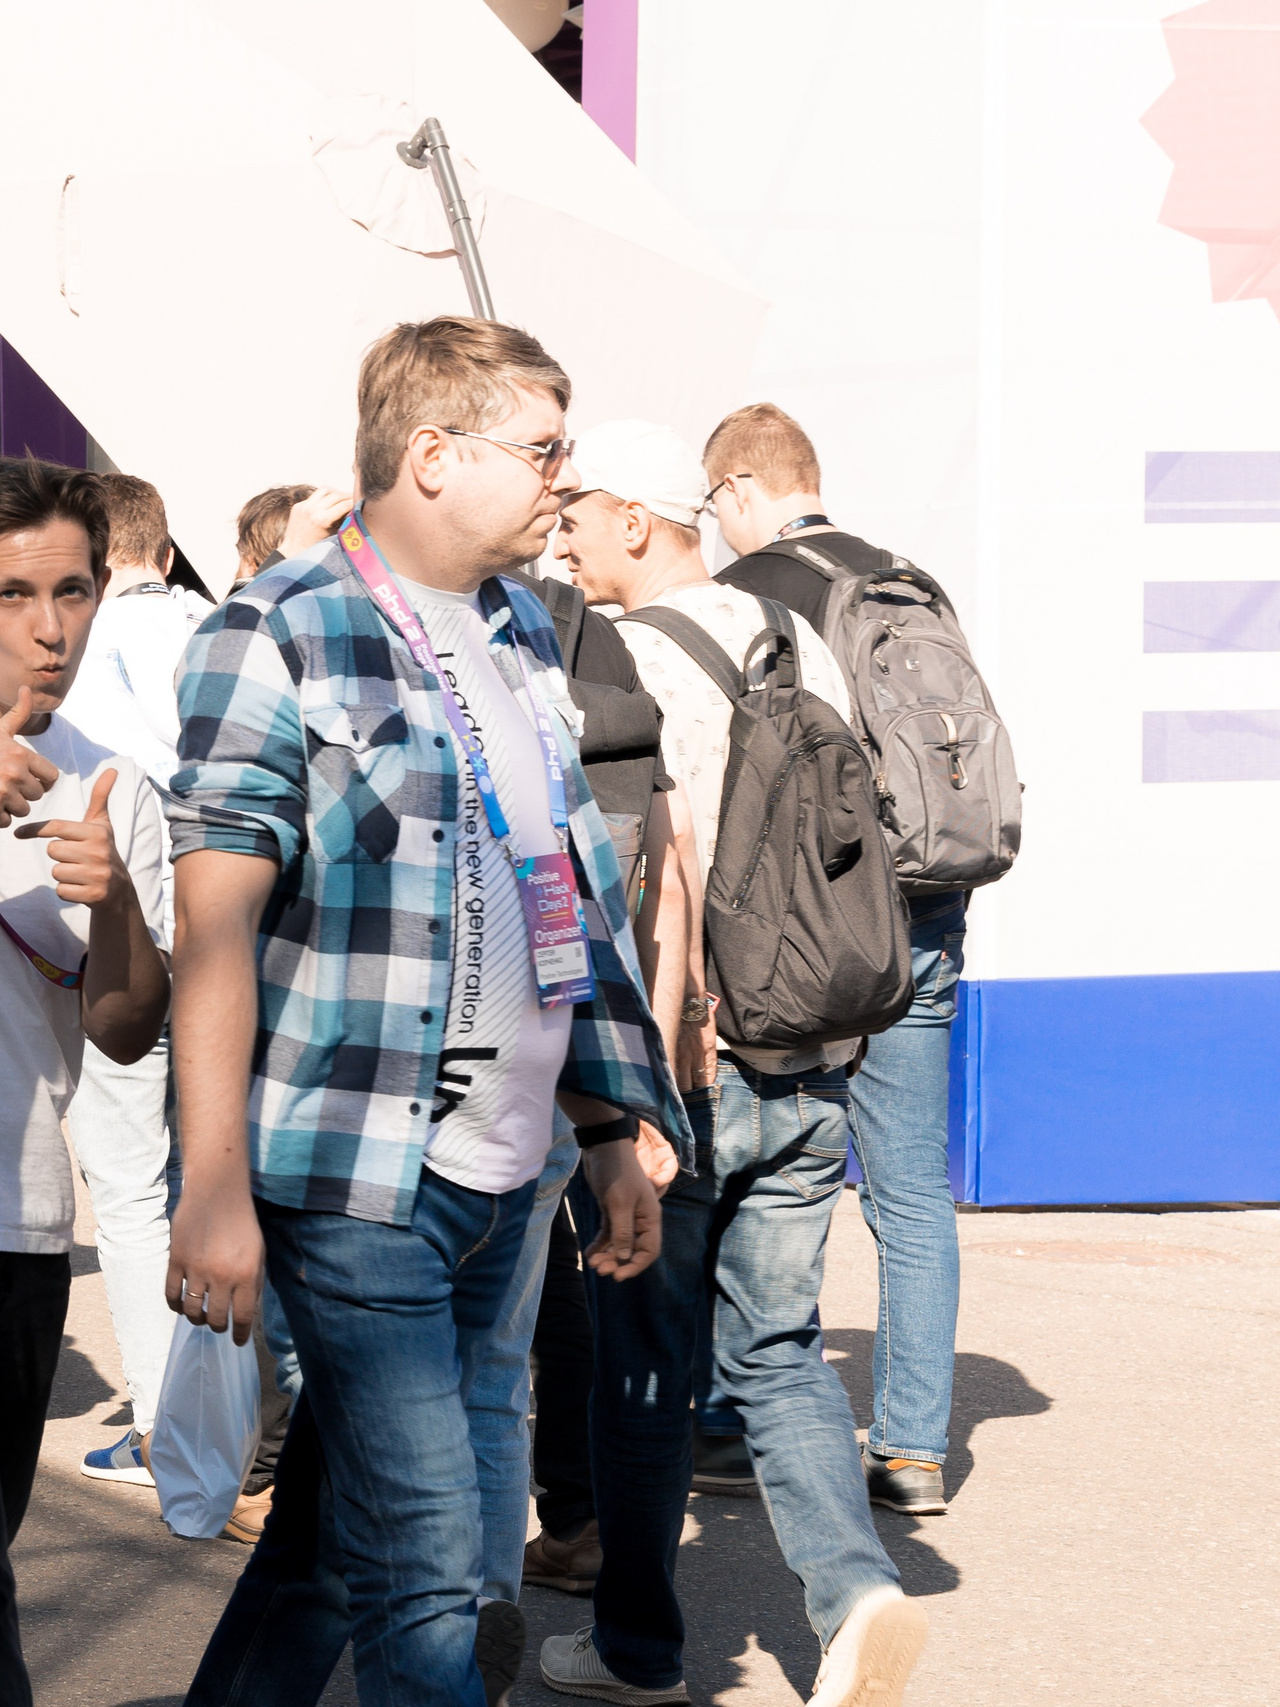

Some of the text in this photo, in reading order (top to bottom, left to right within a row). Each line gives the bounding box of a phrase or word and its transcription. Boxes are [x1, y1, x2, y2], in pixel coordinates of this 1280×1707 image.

[372, 583, 422, 642] phd 2
[538, 717, 563, 781] phd 2
[465, 798, 479, 835] the
[466, 841, 484, 890] new
[527, 871, 560, 886] Positive
[537, 896, 569, 912] Days 2
[543, 882, 571, 897] Hack
[534, 924, 582, 945] Organizer
[458, 897, 485, 1034] generation
